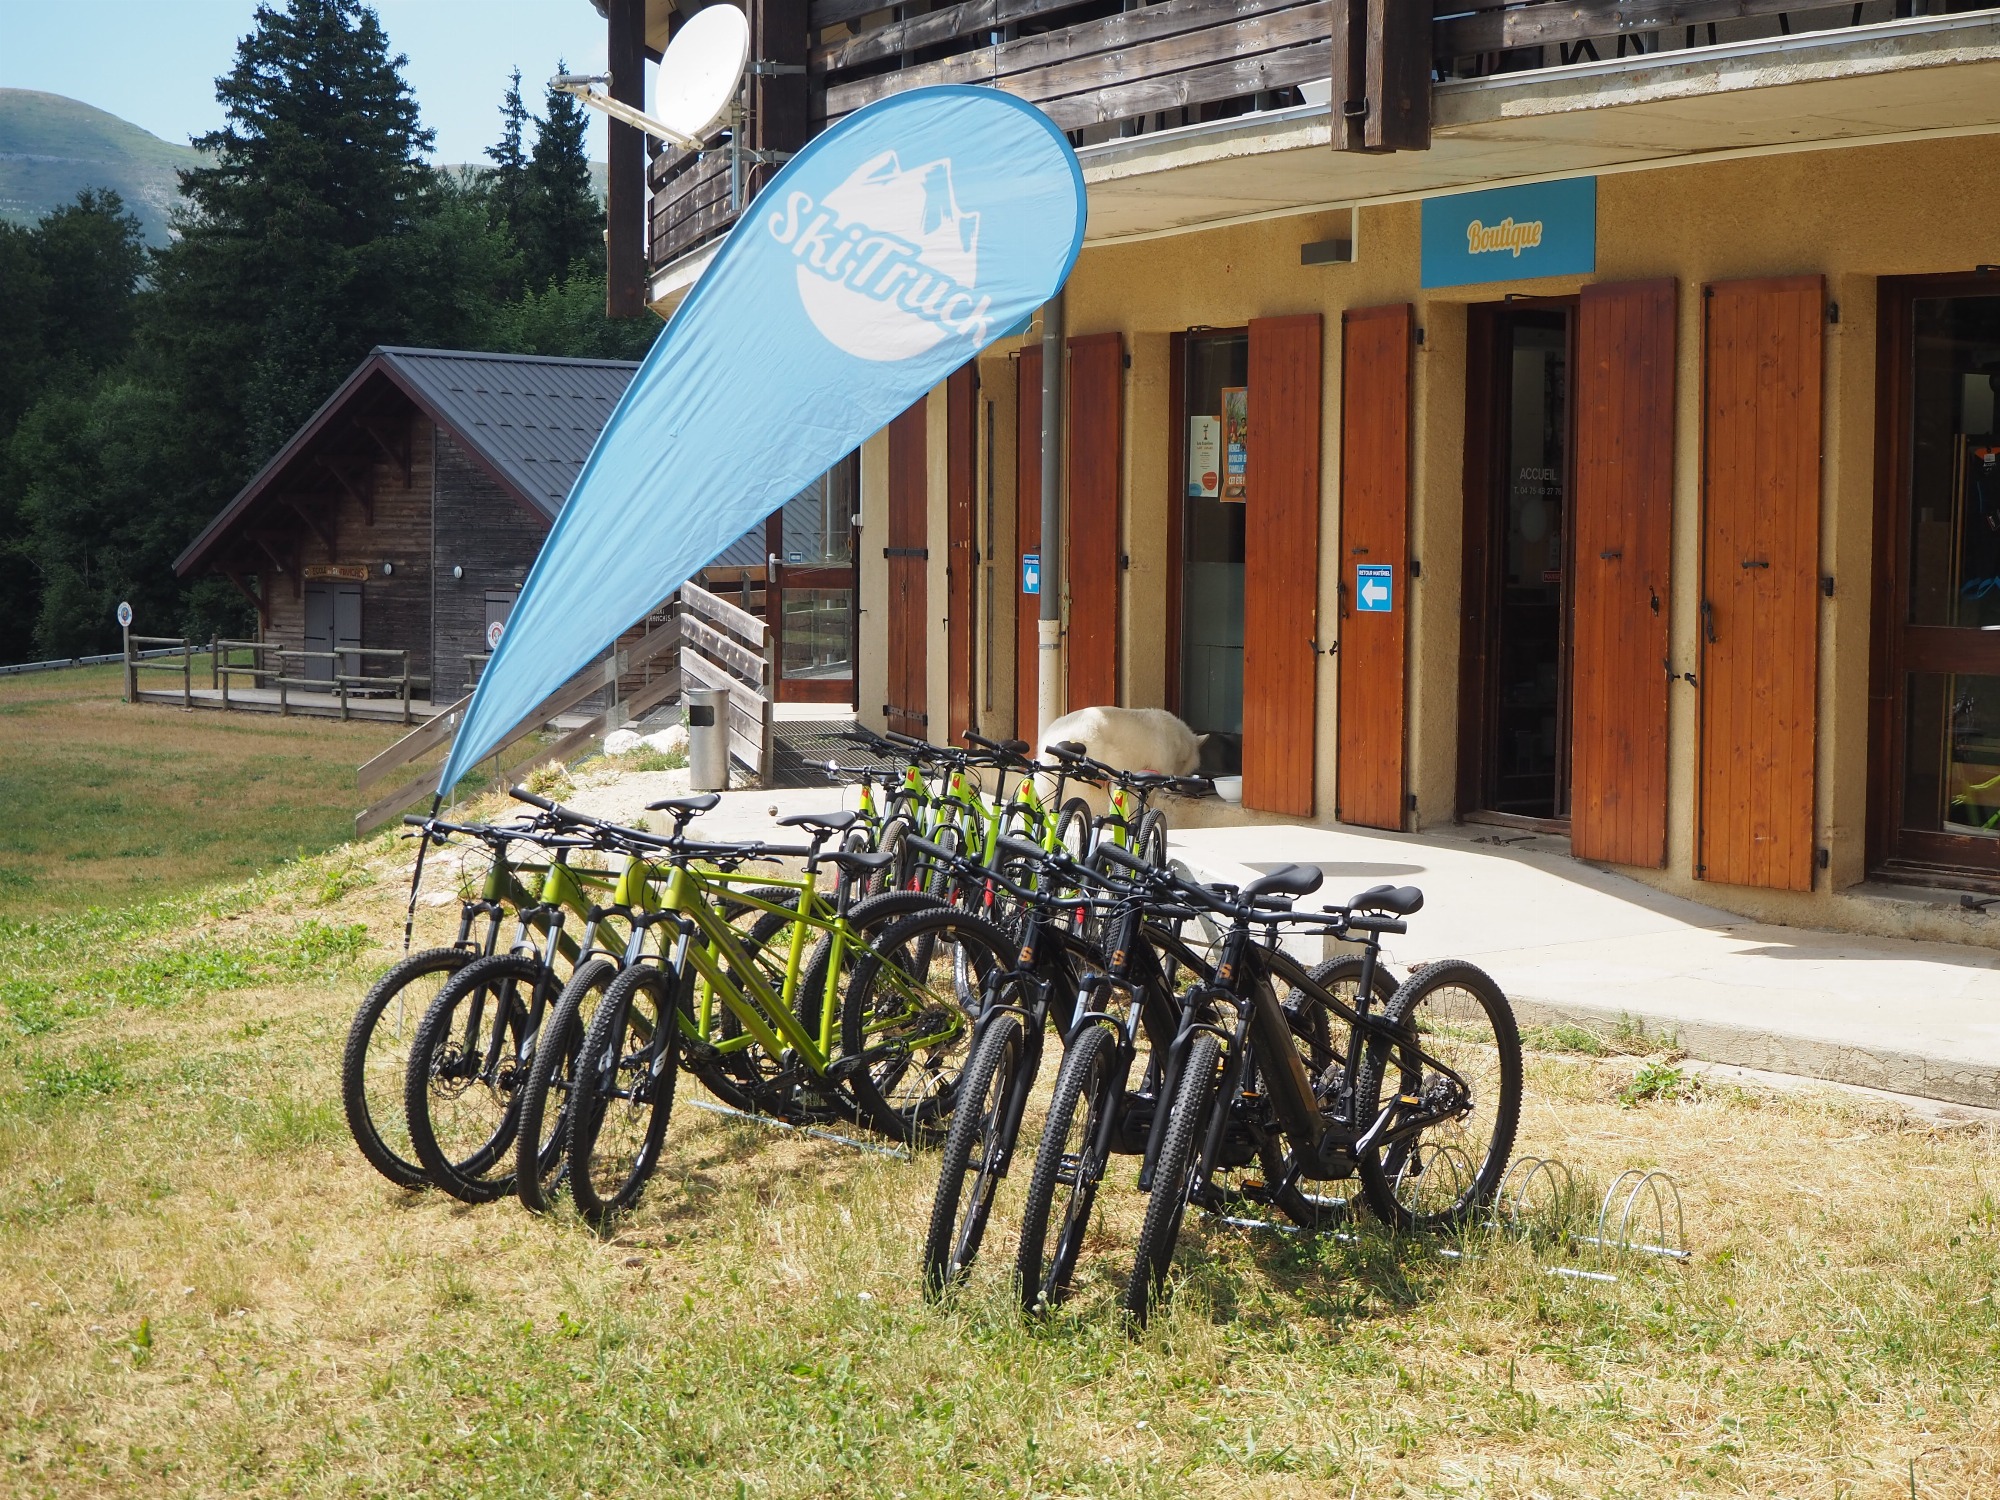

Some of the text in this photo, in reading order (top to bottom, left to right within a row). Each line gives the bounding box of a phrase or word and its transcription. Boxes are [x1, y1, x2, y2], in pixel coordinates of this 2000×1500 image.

[1468, 218, 1542, 257] Boutique
[768, 190, 994, 348] SkiTruck
[1520, 467, 1557, 480] ACCUEIL
